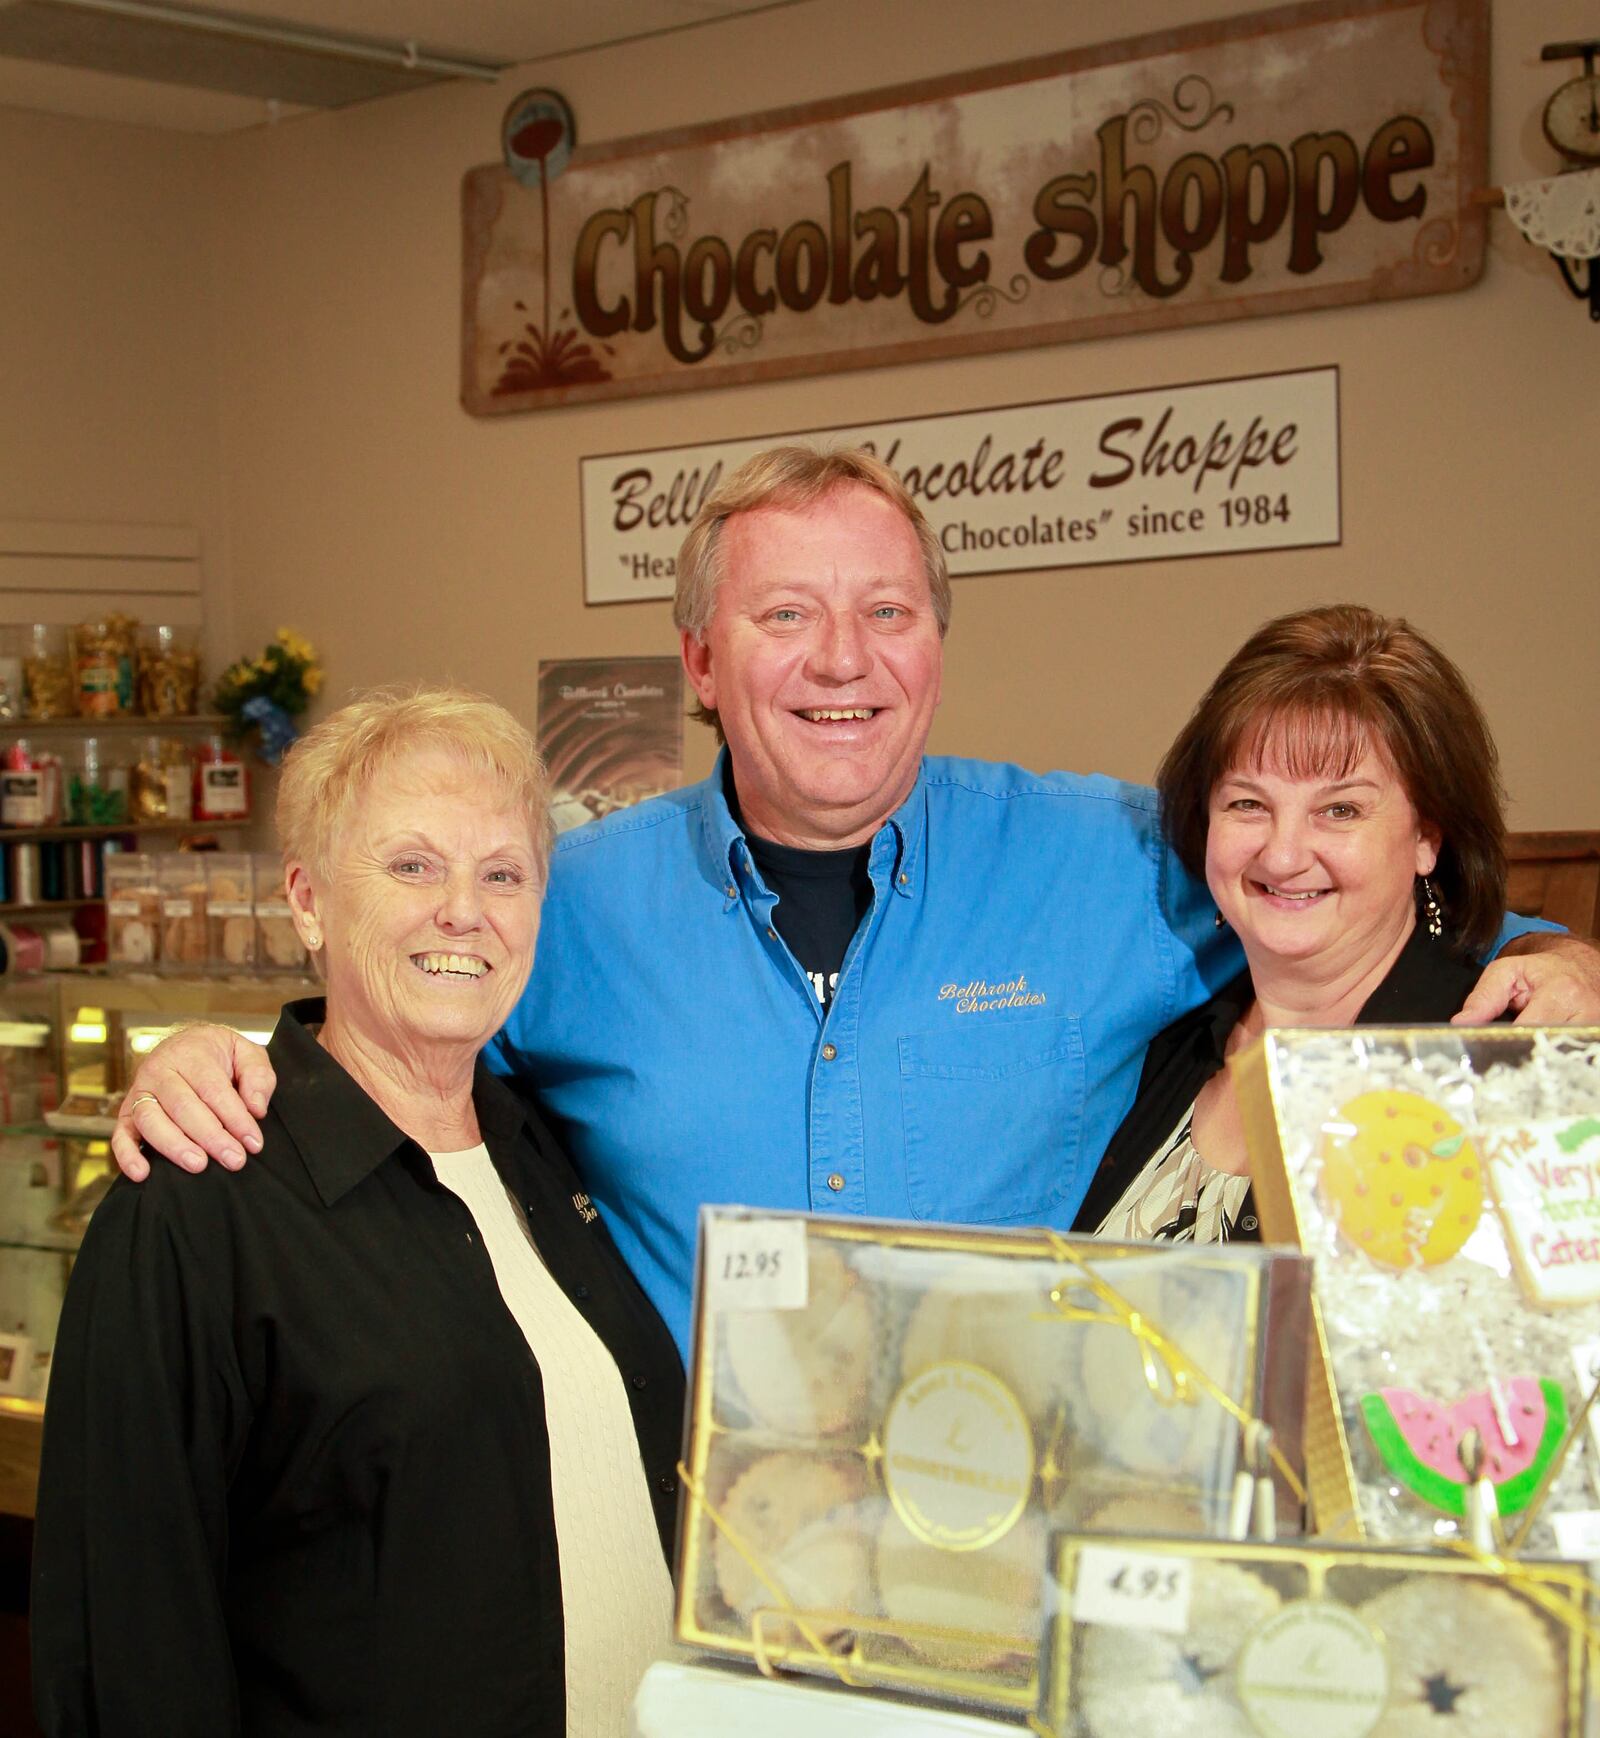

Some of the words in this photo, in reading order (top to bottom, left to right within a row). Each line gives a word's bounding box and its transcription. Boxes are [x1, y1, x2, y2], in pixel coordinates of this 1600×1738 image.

[573, 160, 993, 364] Chocolate
[859, 433, 1065, 501] ocolate
[1088, 406, 1299, 494] Shoppe
[1128, 505, 1205, 537] since
[1219, 493, 1291, 528] 1984
[937, 975, 1028, 1001] Bellbrook
[956, 991, 1047, 1014] Chocolates
[722, 1249, 780, 1280] 12.95
